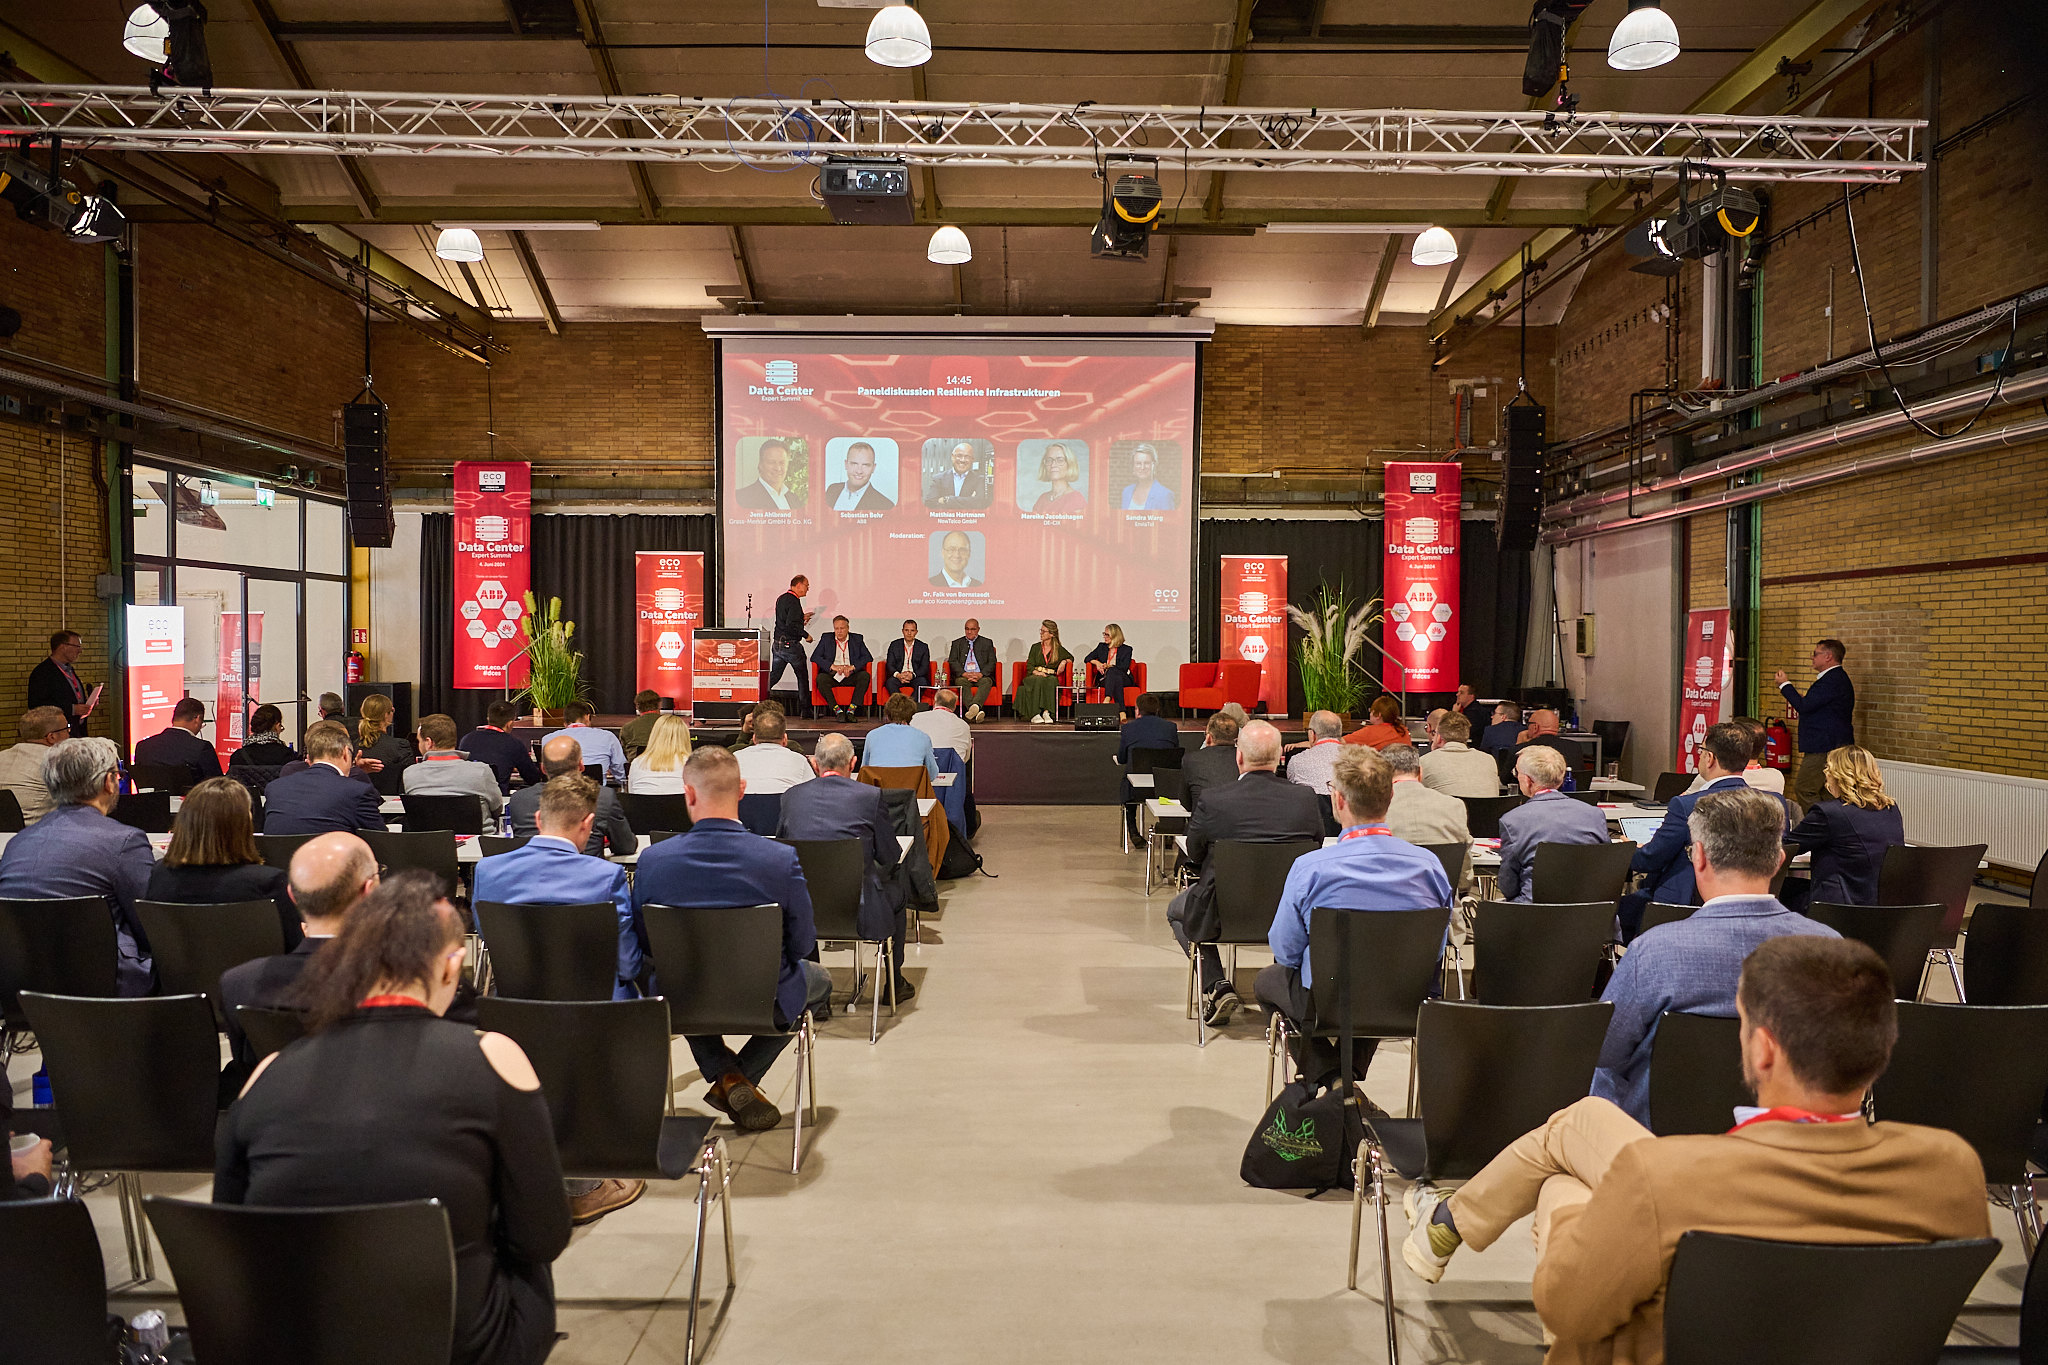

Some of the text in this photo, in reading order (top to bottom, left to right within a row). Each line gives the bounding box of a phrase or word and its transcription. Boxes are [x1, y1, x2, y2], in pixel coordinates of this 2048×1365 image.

[946, 376, 972, 385] 14:45
[748, 385, 814, 396] Data Center
[857, 386, 1061, 397] Paneldiskussion Resiliente Infrastrukturen
[1413, 474, 1433, 482] eco
[458, 541, 525, 553] Data Center
[1388, 544, 1455, 554] Data Center
[659, 558, 681, 566] eco
[1243, 562, 1265, 570] eco
[480, 589, 504, 600] ABB
[1154, 589, 1179, 598] eco
[1409, 592, 1434, 602] ABB
[640, 610, 698, 620] Data Center
[1225, 614, 1282, 623] Data Center
[660, 641, 681, 650] ABB
[1243, 645, 1265, 653] ABB
[221, 673, 236, 682] Data
[1685, 687, 1720, 700] Data Center
